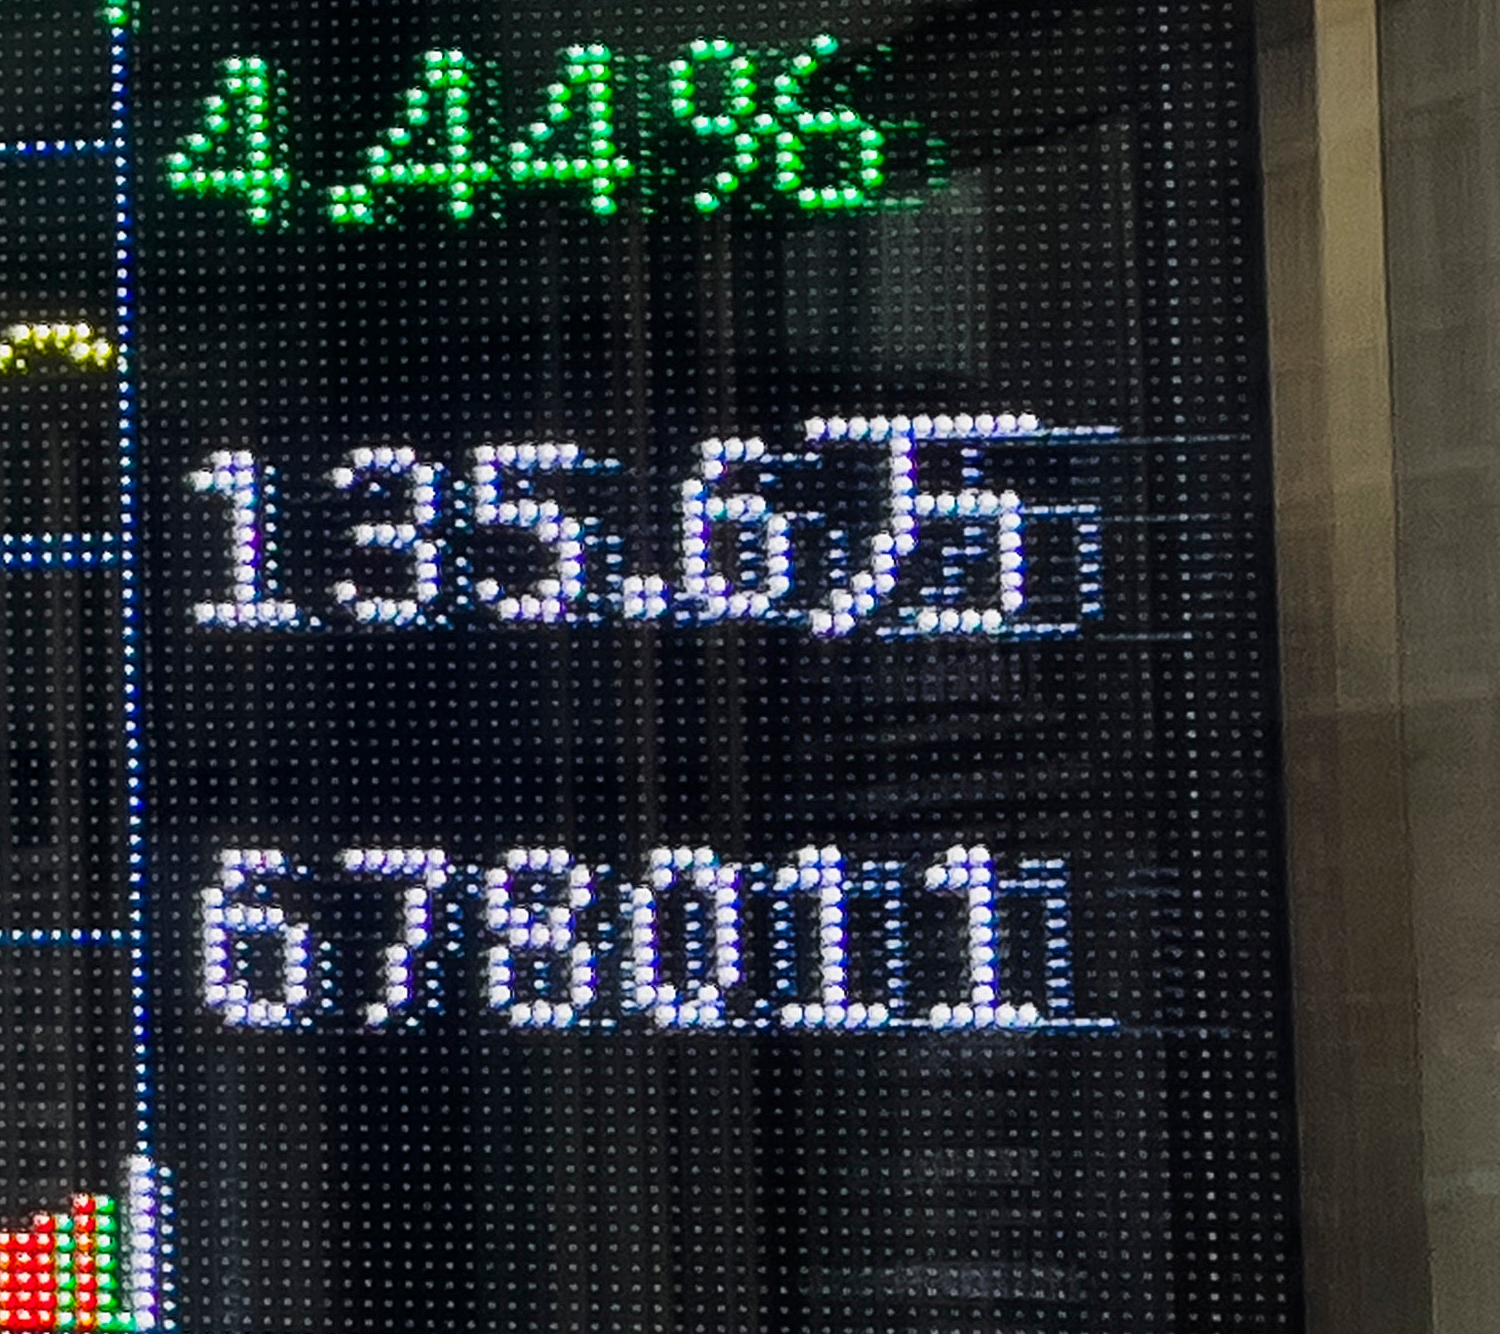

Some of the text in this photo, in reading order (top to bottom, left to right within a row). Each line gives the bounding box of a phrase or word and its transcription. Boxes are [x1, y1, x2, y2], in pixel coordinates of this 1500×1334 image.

[166, 31, 886, 227] 4.44%
[184, 411, 1040, 637] 135.6万
[198, 843, 1040, 1029] 678011
